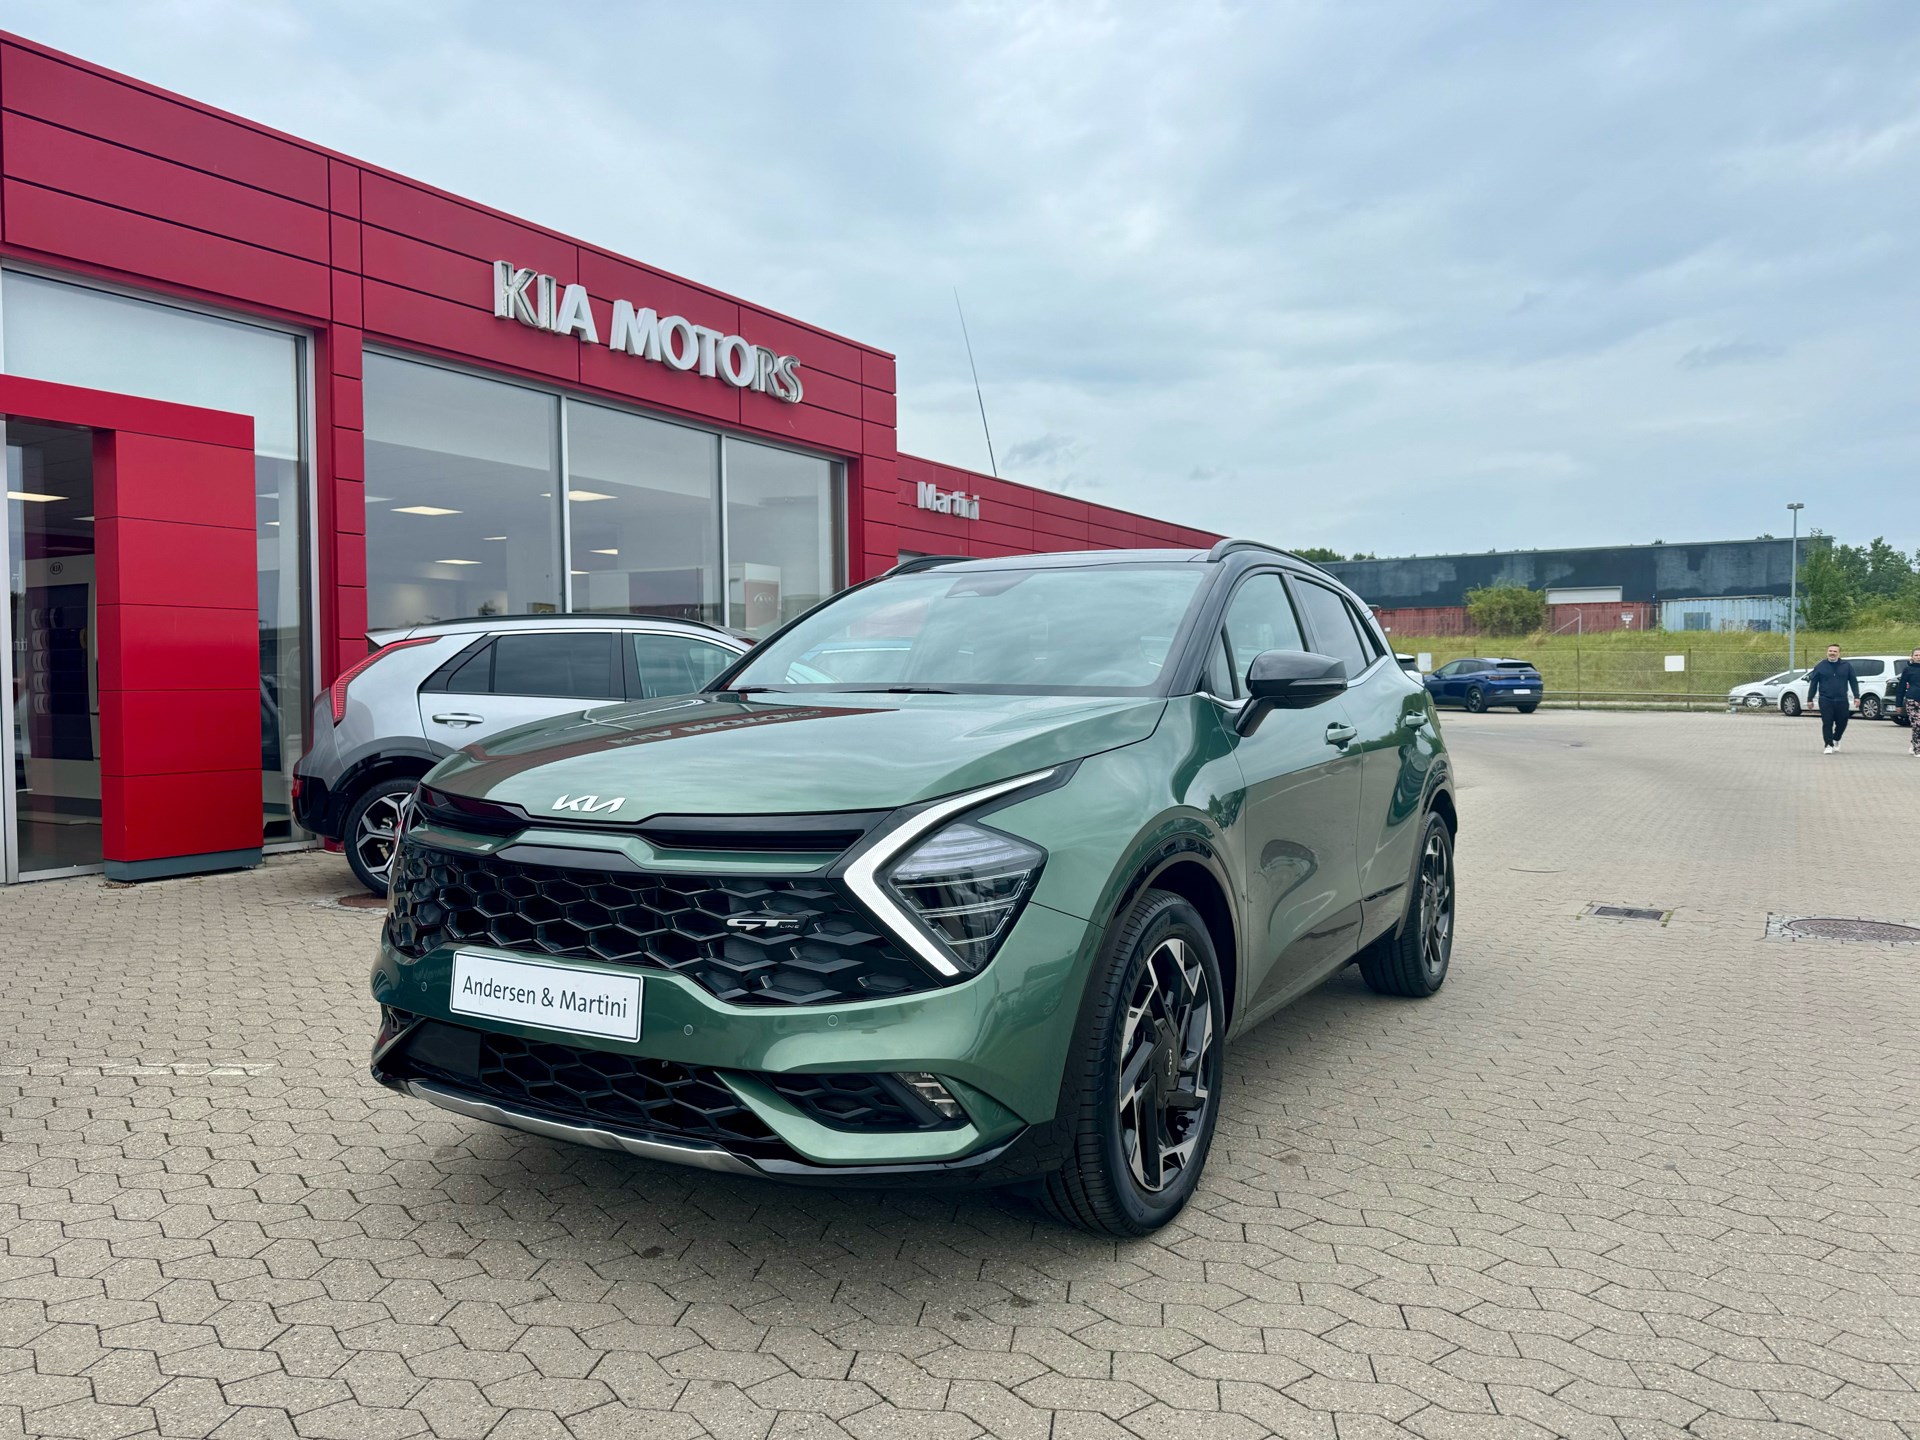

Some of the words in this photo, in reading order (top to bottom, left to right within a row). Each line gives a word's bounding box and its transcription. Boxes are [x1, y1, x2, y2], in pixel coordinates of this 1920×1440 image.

[493, 260, 599, 344] KIA
[609, 299, 804, 403] MOTORS
[917, 481, 979, 520] Martini
[462, 975, 536, 1004] Andersen
[541, 987, 554, 1008] &
[559, 990, 627, 1018] Martini
